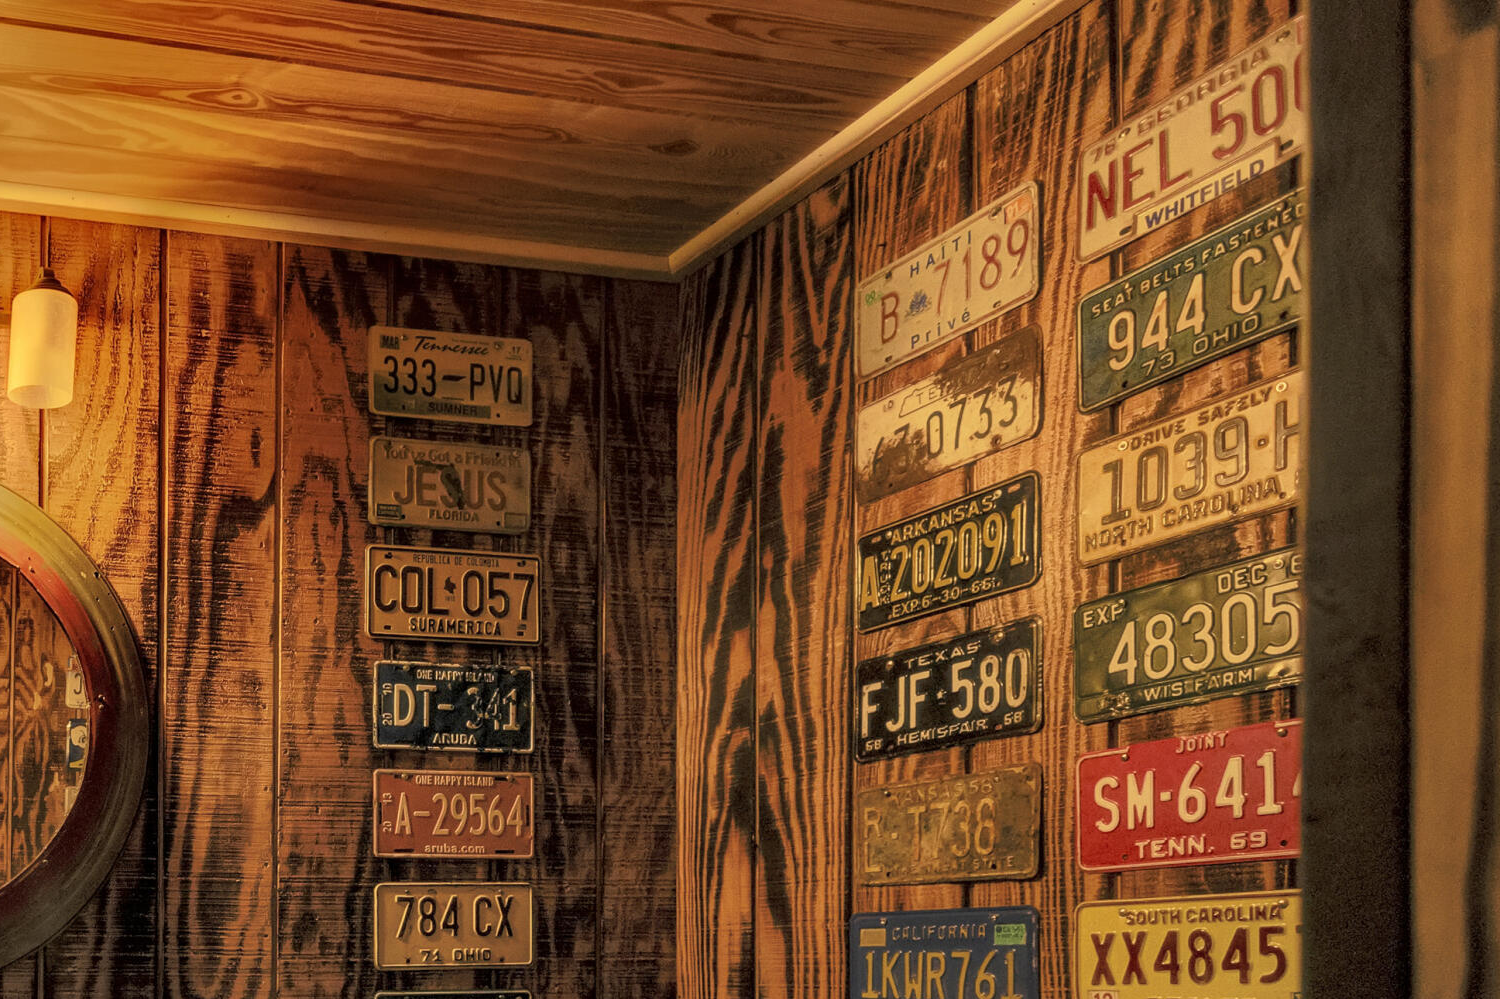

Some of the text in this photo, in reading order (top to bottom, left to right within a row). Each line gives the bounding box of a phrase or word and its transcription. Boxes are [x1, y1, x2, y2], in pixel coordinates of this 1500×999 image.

[1137, 47, 1269, 136] GEORGIA
[1086, 129, 1192, 231] NEL
[1145, 159, 1265, 229] WHITFIELD
[934, 218, 1029, 316] 7189
[1092, 287, 1133, 318] SEAT
[1140, 258, 1195, 294] BELTS
[1108, 224, 1302, 371] 944 CX
[911, 308, 970, 349] Privé
[415, 336, 489, 355] Tennessee
[1142, 315, 1259, 376] 73 OHIO
[429, 402, 478, 416] SUMNER
[1130, 387, 1272, 450] DRIVE SAFELY
[393, 465, 506, 511] JESUS
[429, 509, 479, 522] FLORIDA
[891, 495, 996, 545] ARKANSAS
[1085, 477, 1280, 552] NORTH CAROLINA
[413, 554, 499, 567] REPUBLICA DE COLOMBIA
[1218, 564, 1266, 594] DEC
[410, 618, 500, 635] SURAMERICA
[1108, 580, 1300, 685] 48305
[905, 641, 981, 669] TEXAS
[417, 670, 432, 679] ONE
[436, 671, 463, 680] HAPPY
[1144, 669, 1252, 701] WIS FARM
[433, 733, 476, 744] ARUBA
[897, 719, 988, 745] HEMISFAIR
[1176, 731, 1229, 753] JOINT
[416, 776, 494, 786] ONE HAPPY ISLAND
[1094, 749, 1302, 832] SM-641
[395, 792, 523, 837] A-29564
[425, 844, 484, 853] aruba.com
[1135, 831, 1267, 859] TENN. 69
[395, 895, 514, 938] 784 CX
[1126, 904, 1282, 925] SOUTH CAROLINA
[892, 923, 987, 941] CALIFORNIA
[452, 948, 491, 961] OHIO
